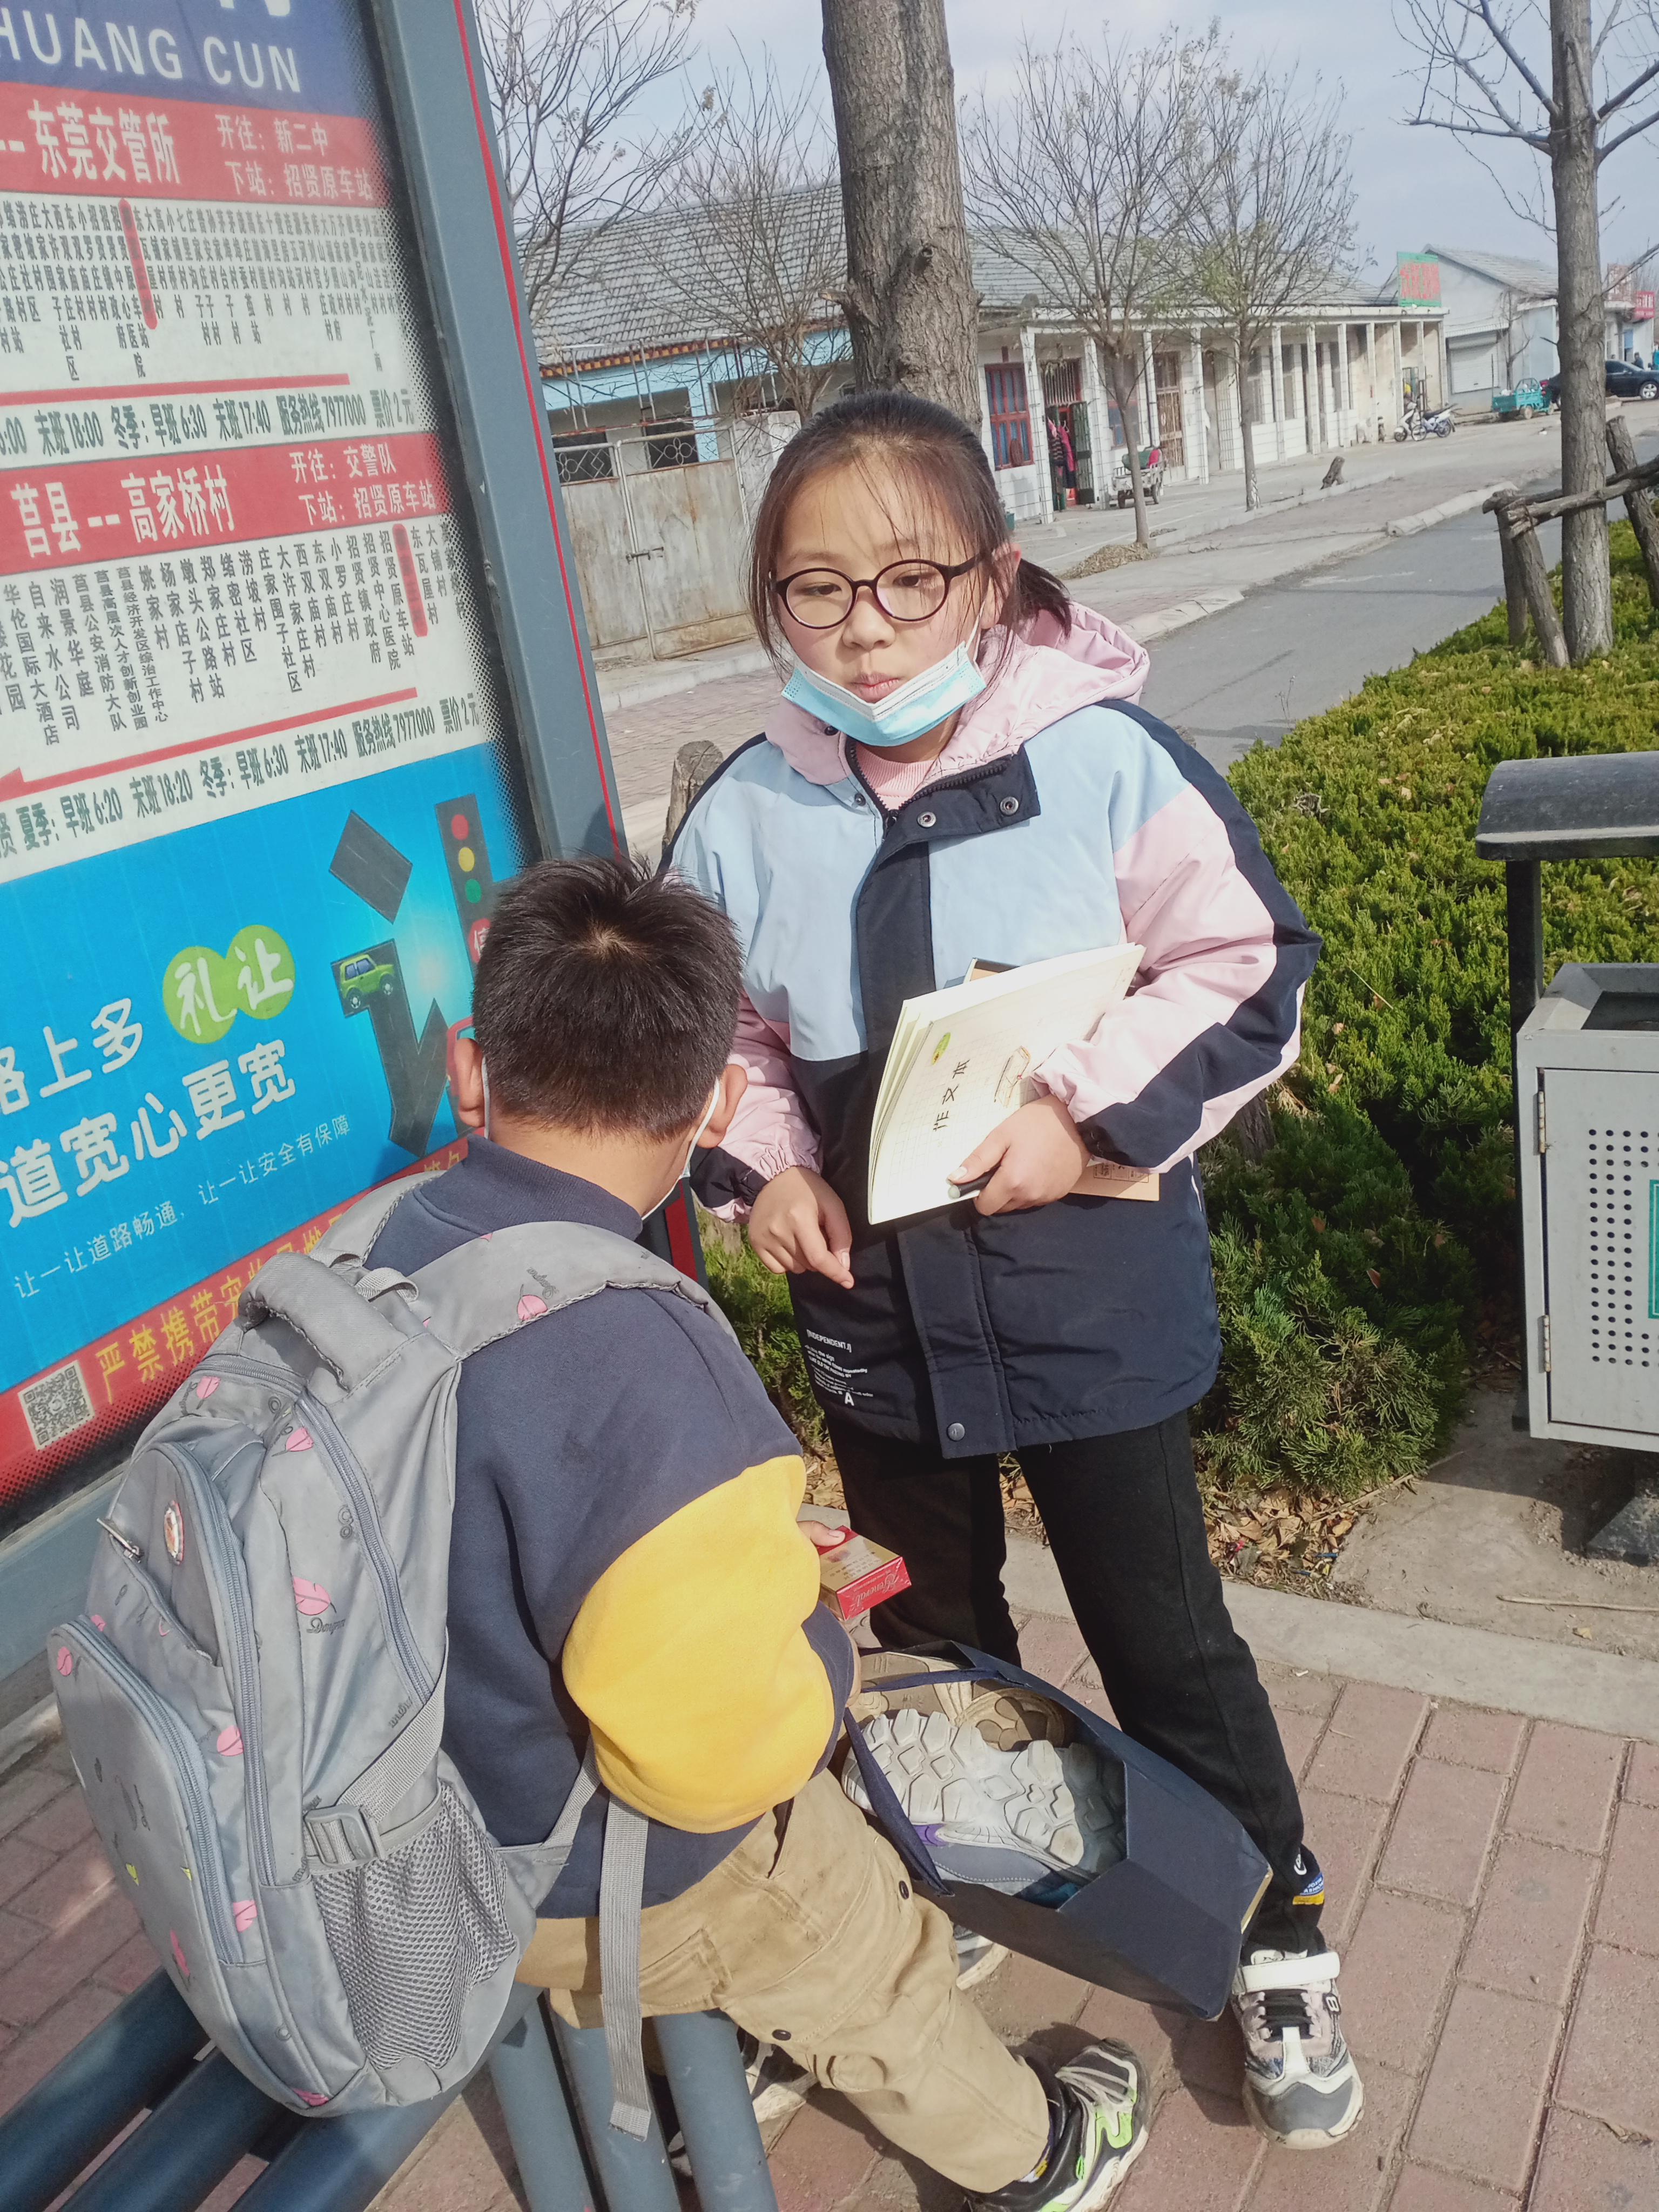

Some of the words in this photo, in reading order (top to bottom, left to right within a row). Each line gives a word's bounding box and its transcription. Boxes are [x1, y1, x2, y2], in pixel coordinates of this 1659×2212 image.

[203, 36, 301, 93] CUN
[50, 578, 95, 697] 润景华庭
[139, 565, 170, 650] 姚家村
[160, 562, 204, 703] 杨家店子村
[200, 555, 236, 666] 郑家庄村
[238, 550, 267, 632] 涝坡村
[258, 547, 302, 693] 庄家围子社区
[277, 545, 315, 678] 大许家庄村
[294, 543, 327, 648] 西双庙村
[313, 539, 343, 645] 东双庙村
[331, 537, 359, 642] 小罗庄村
[346, 535, 381, 664] 招贤镇政府
[363, 532, 401, 671] 招贤中心医院
[379, 530, 415, 656] 招贤原车站
[410, 526, 439, 625] 东瓦屋村
[3, 584, 60, 746] 华伦国际大酒店
[29, 581, 80, 731] 自来水公司
[72, 574, 127, 731] 莒县公安消防大队
[94, 570, 149, 730] 莒县高层次人才创新创业园
[116, 567, 168, 723] 莒县经济开发区综治工作中心
[174, 938, 294, 1036] 礼让
[0, 1040, 295, 1229] 道宽心更宽
[198, 1114, 351, 1205] 让一让安全有保障
